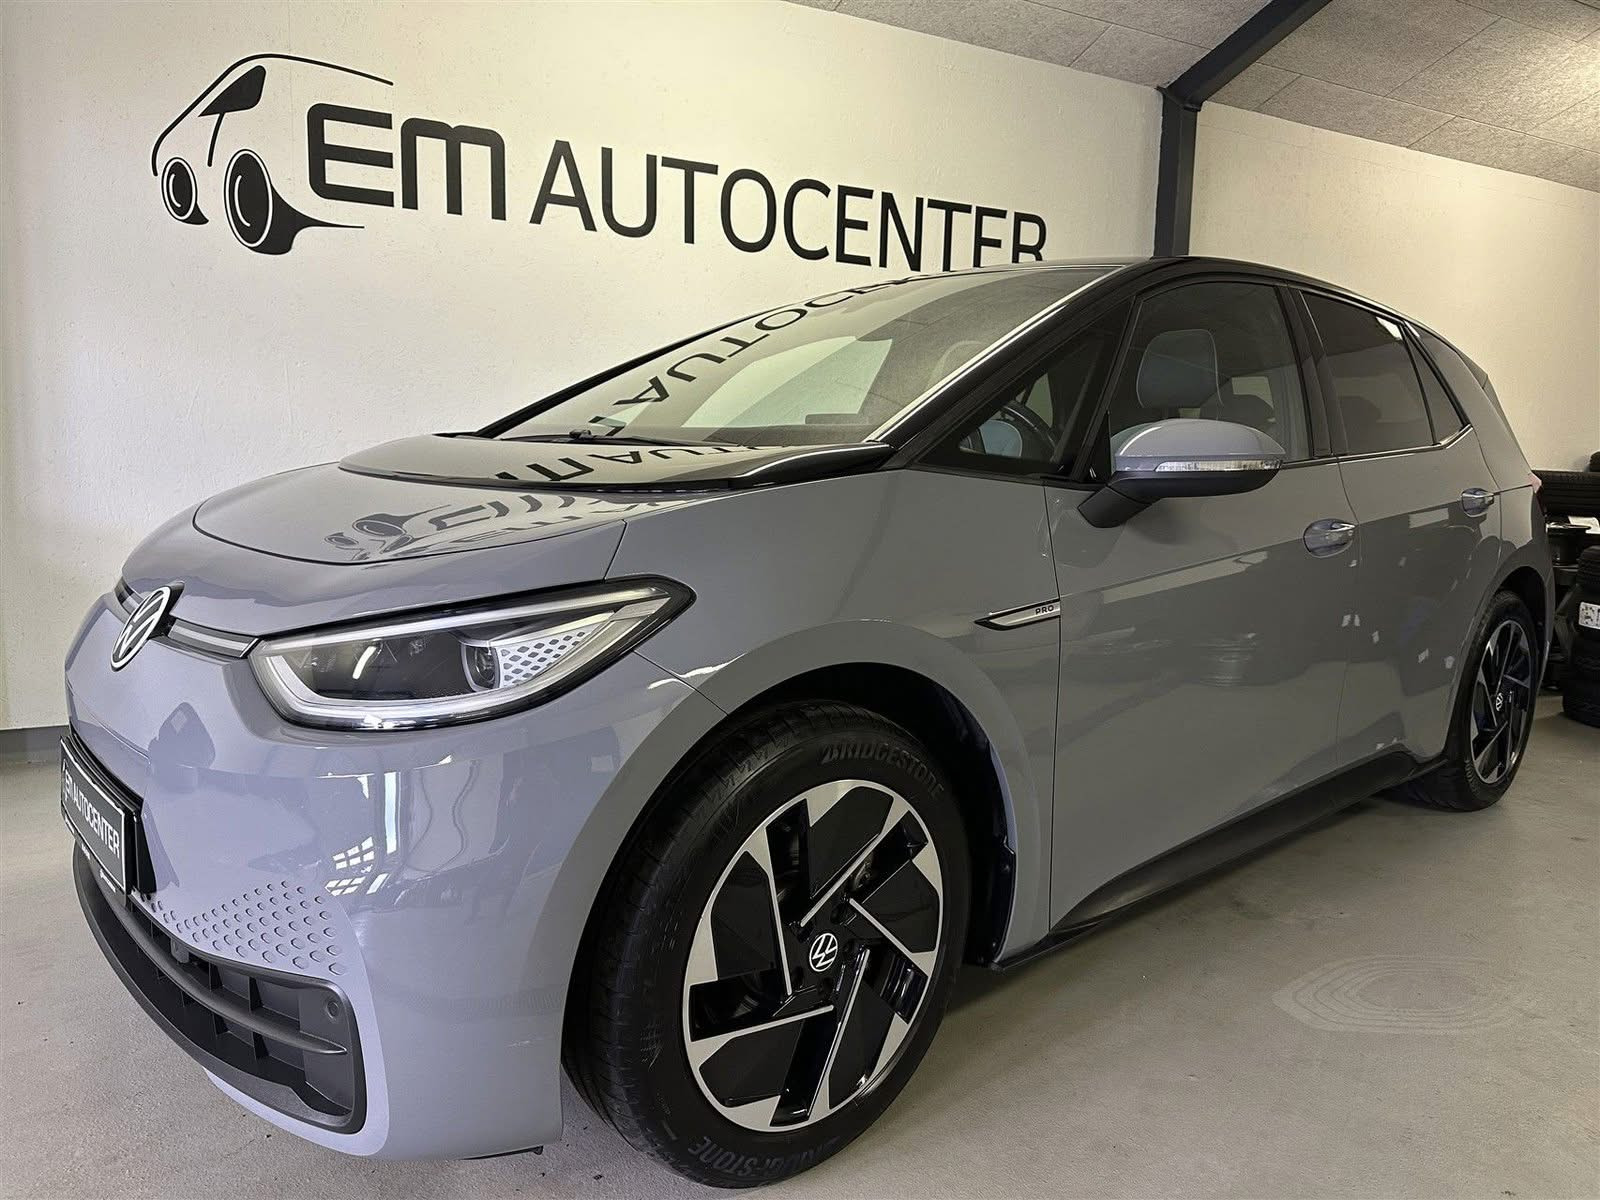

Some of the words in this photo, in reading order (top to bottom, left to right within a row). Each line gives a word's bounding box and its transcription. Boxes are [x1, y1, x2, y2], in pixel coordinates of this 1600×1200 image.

[529, 139, 1047, 272] AUTOCENTER
[1035, 605, 1055, 615] PRO
[73, 782, 120, 859] AUTOCENTER
